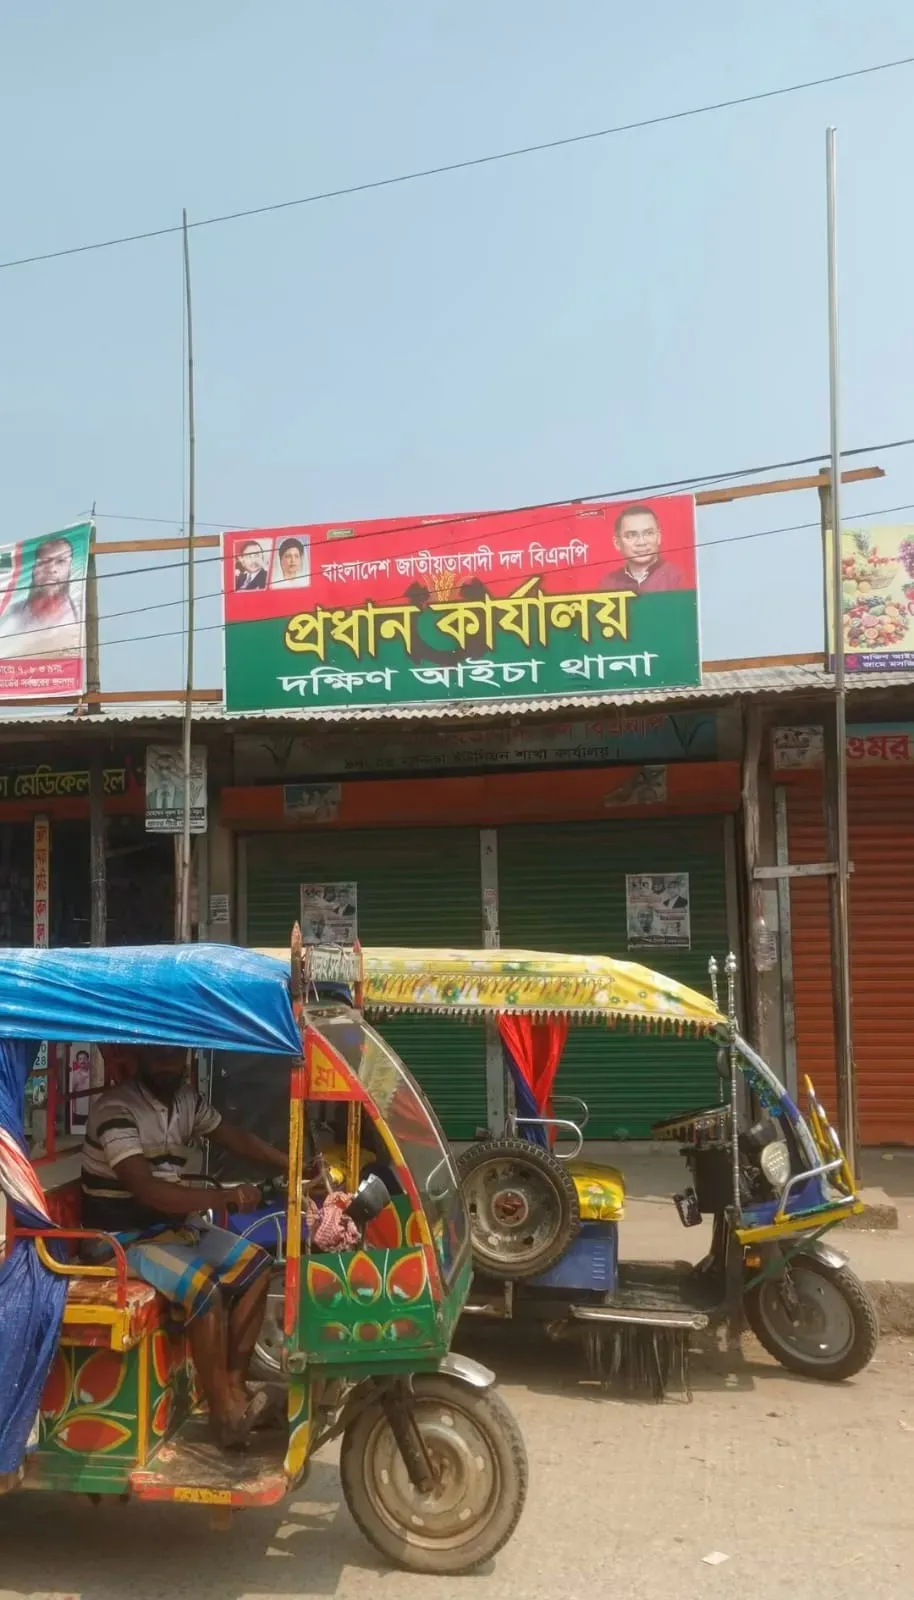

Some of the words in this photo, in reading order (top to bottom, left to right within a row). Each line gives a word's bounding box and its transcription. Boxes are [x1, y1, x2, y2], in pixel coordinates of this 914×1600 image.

[321, 558, 391, 584] বাংলাদেশ
[395, 544, 493, 577] জাতীয়তাবাদী
[498, 548, 523, 570] দল
[528, 538, 589, 568] বিএনপি
[285, 602, 421, 661] প্রধান
[430, 577, 637, 651] কার্যালয়
[277, 665, 399, 697] দক্ষিণ
[409, 656, 545, 690] আইচা
[560, 651, 659, 679] থানা
[14, 764, 92, 797] মেডিকেল
